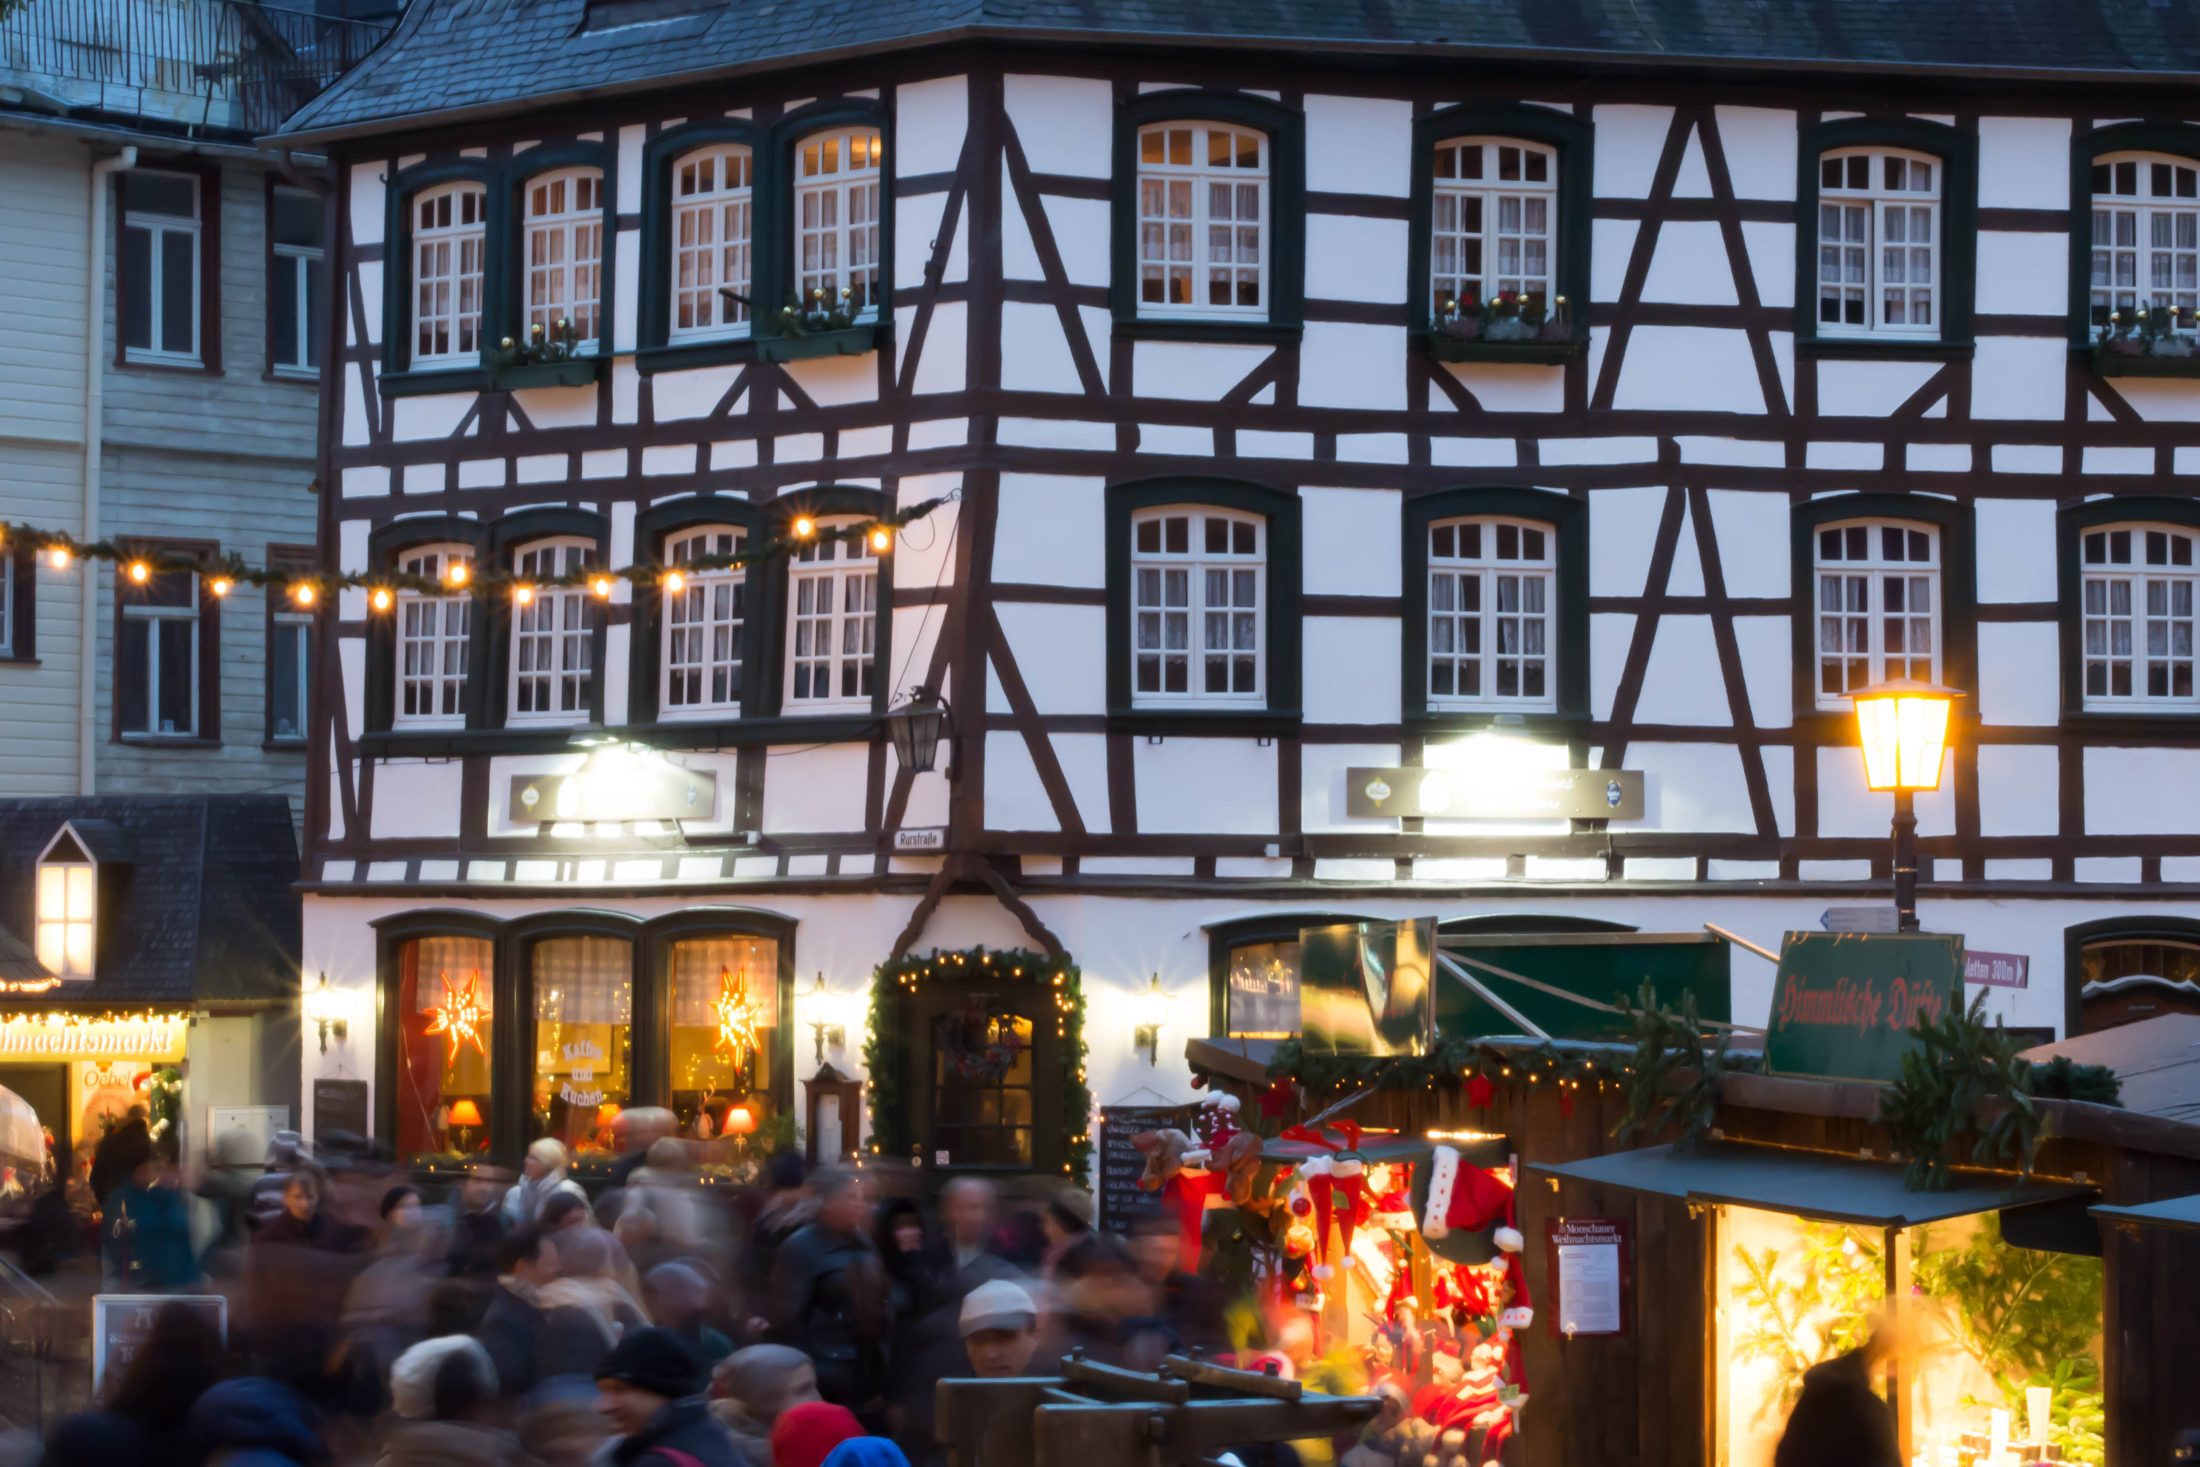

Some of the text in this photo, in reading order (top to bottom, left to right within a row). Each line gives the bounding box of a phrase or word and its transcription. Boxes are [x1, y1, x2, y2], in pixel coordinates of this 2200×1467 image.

[900, 831, 938, 846] Rurstraße
[1991, 959, 2014, 981] 300m
[1779, 975, 1882, 1038] Himmlische
[0, 1023, 173, 1053] hnachtsmarkt
[560, 1081, 604, 1107] Kuchen
[1552, 1233, 1623, 1244] Weihnachtsmarkt
[1566, 1223, 1617, 1234] Monschauer
